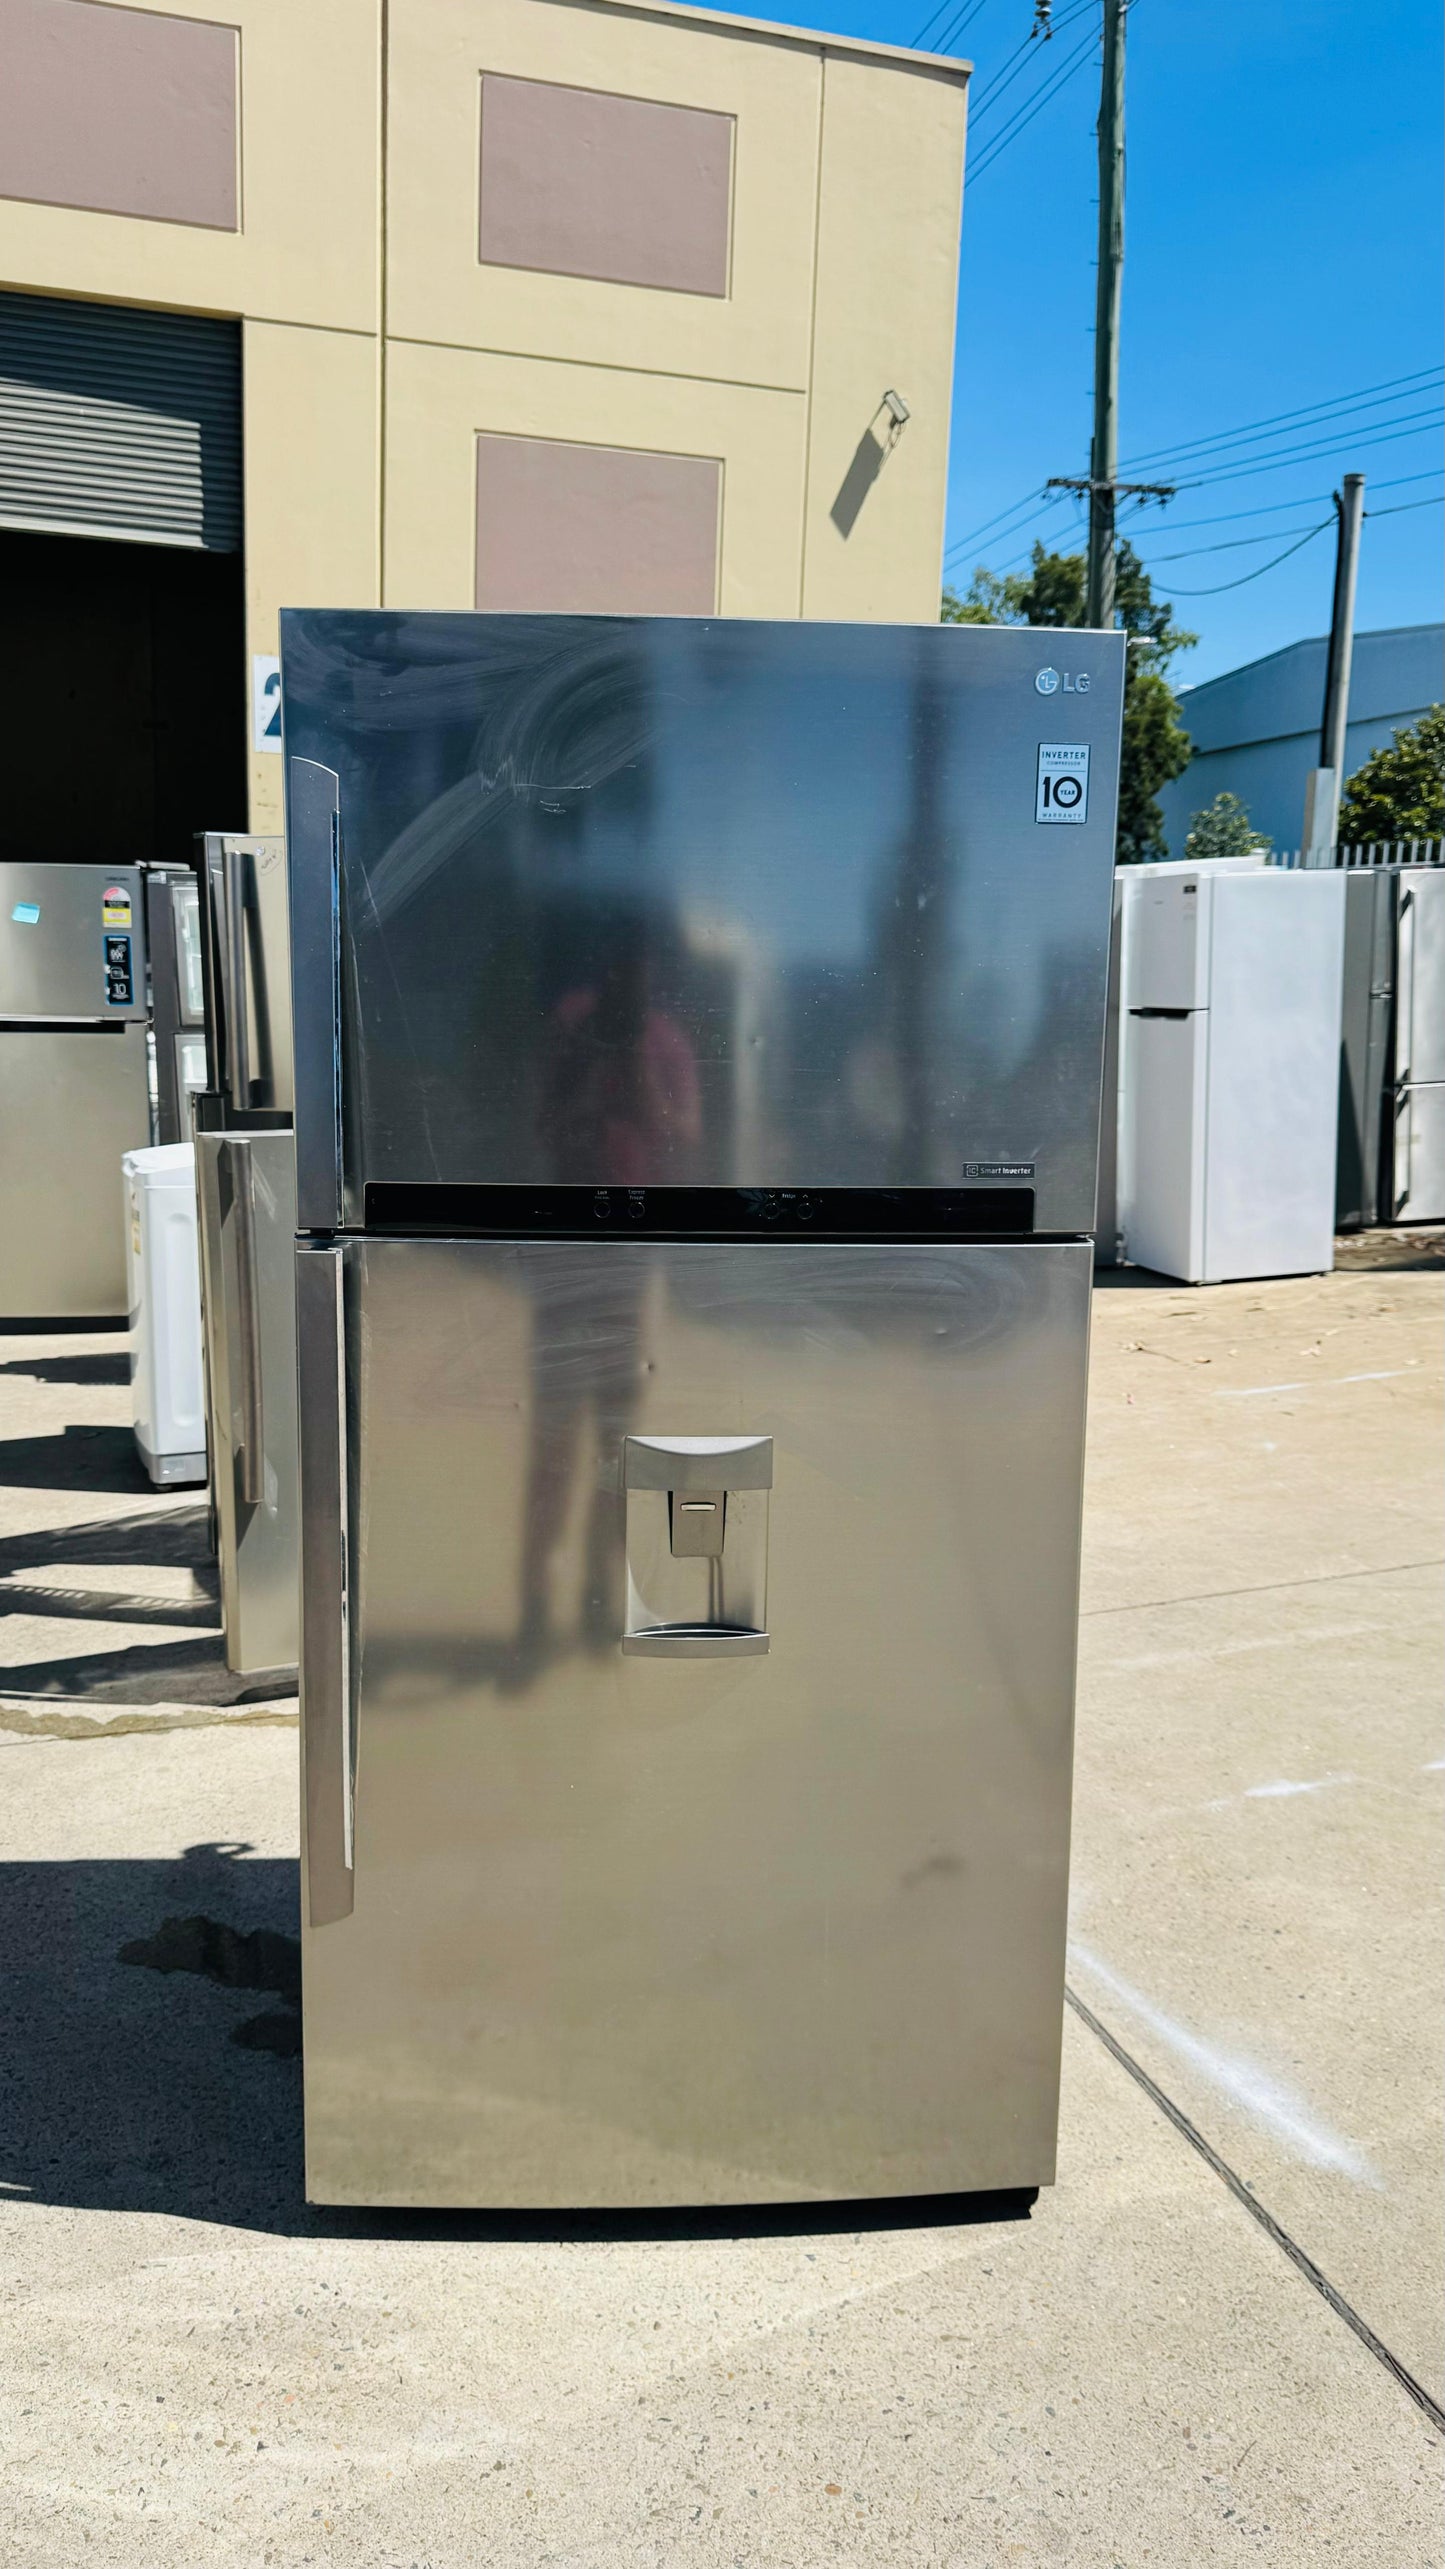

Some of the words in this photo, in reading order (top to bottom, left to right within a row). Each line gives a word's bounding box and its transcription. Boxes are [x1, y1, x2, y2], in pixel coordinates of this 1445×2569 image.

[1062, 672, 1090, 693] LG
[1042, 751, 1086, 760] INVERTER
[1042, 776, 1082, 808] 10
